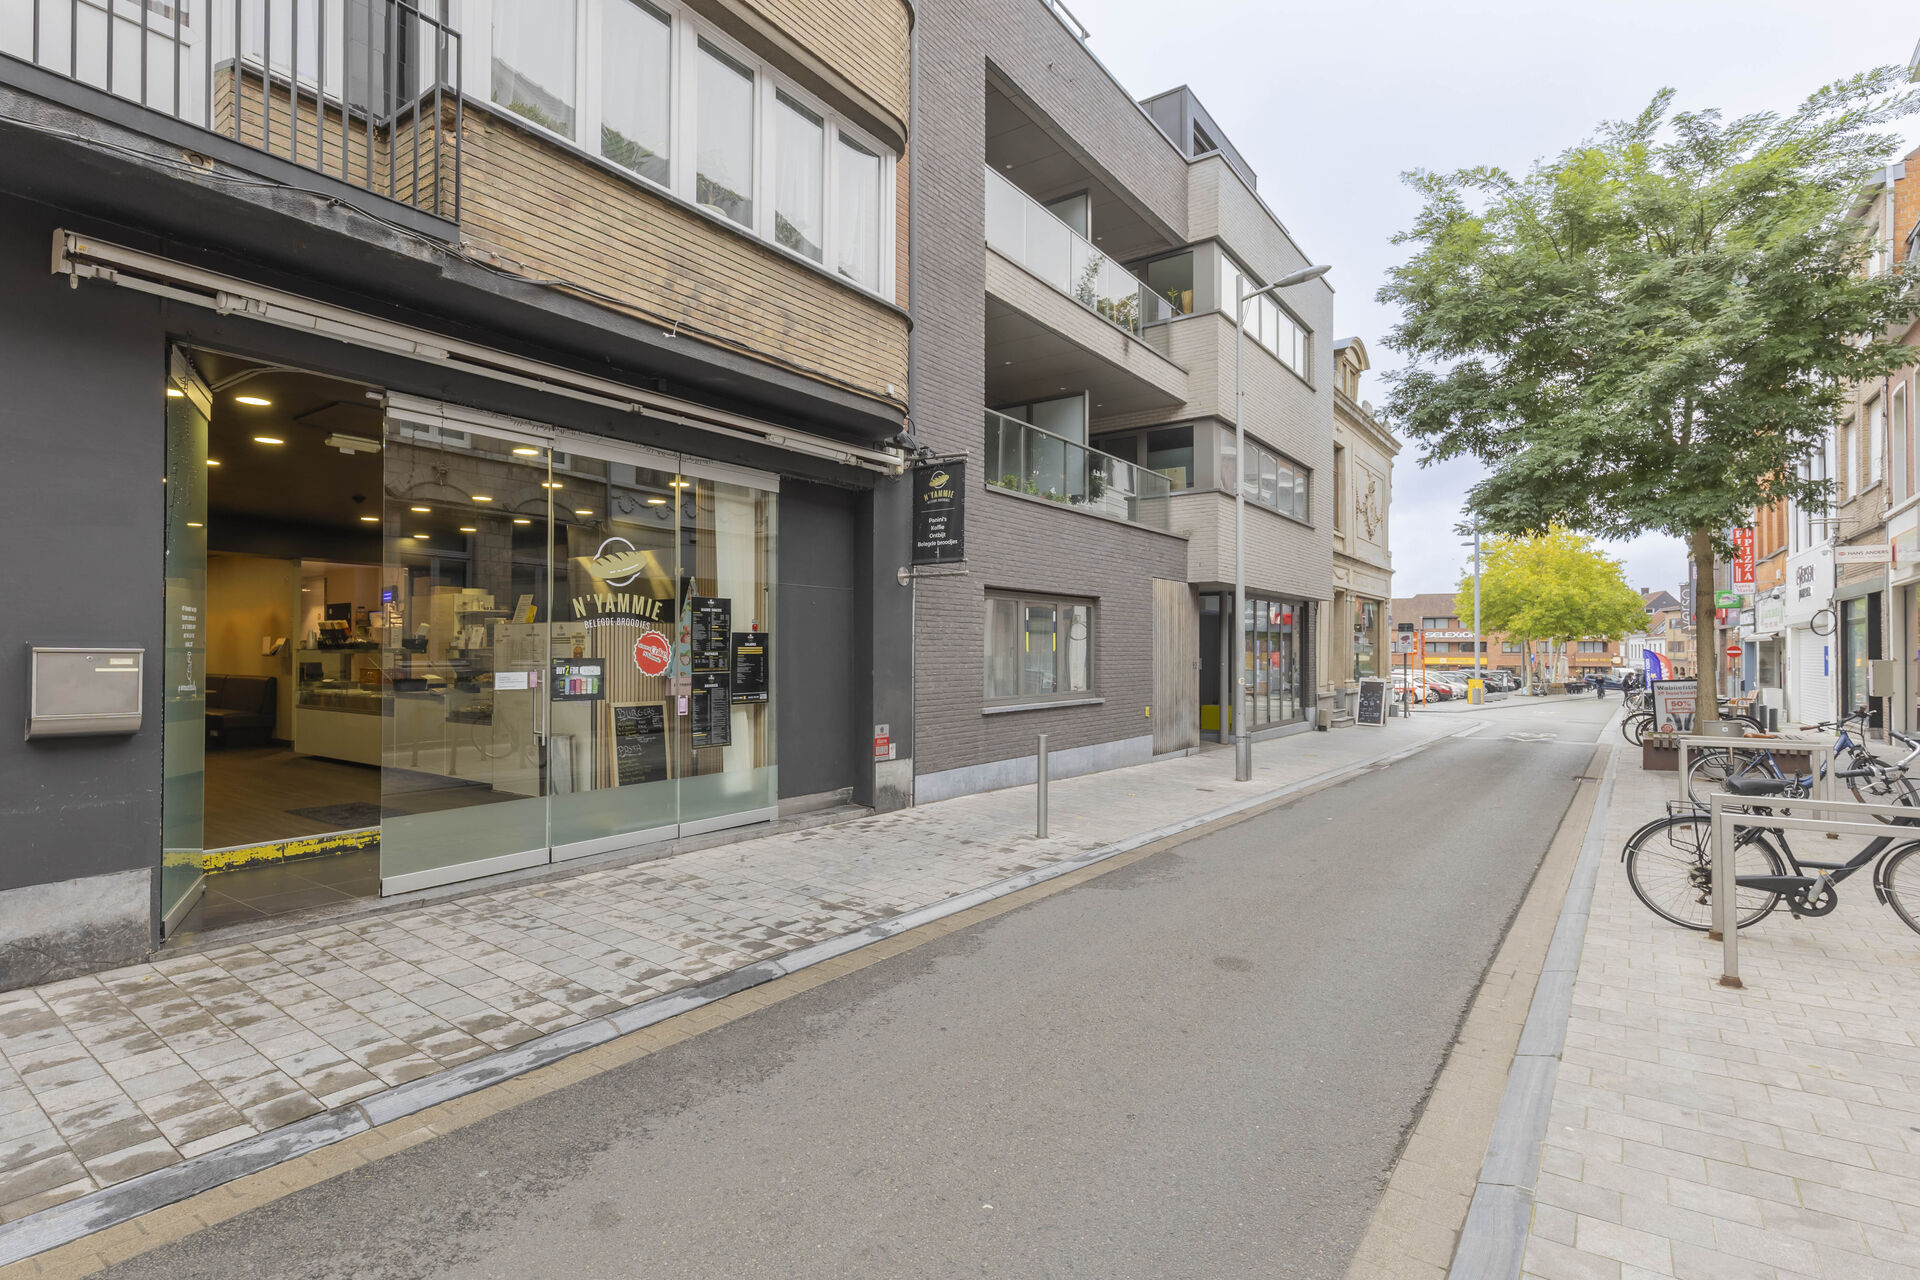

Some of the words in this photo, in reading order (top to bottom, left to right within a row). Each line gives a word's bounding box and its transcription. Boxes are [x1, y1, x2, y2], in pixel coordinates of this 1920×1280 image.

[924, 490, 954, 501] N'YAMMIE
[1743, 538, 1752, 580] PIZZA
[572, 593, 663, 621] N'YAMMIE
[584, 617, 615, 630] BELEGDE
[616, 617, 651, 630] BROODJES
[556, 666, 565, 675] BUY
[565, 665, 570, 676] 2
[570, 666, 579, 675] FOR
